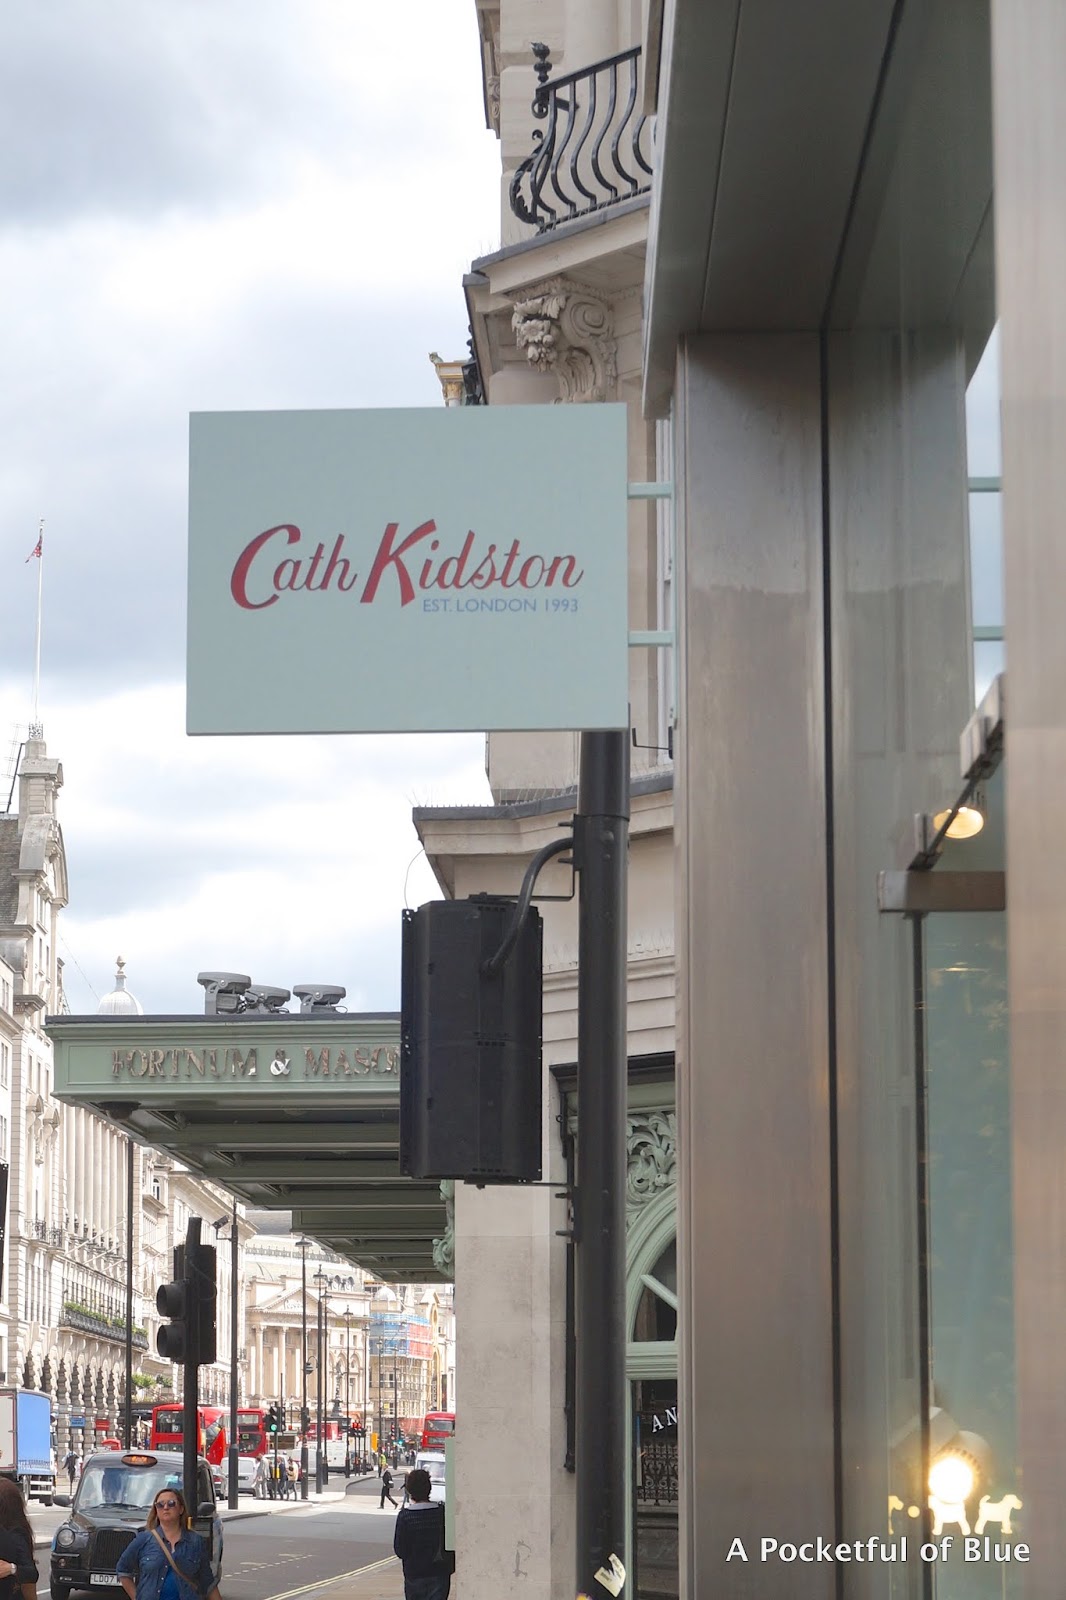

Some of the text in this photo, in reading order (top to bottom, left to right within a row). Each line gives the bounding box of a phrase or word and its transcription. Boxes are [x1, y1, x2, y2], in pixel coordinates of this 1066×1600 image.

[230, 518, 584, 610] Cath Kidston
[423, 598, 579, 613] EST. LONDON 1993
[111, 1047, 258, 1077] FORTNUM
[269, 1047, 292, 1077] &
